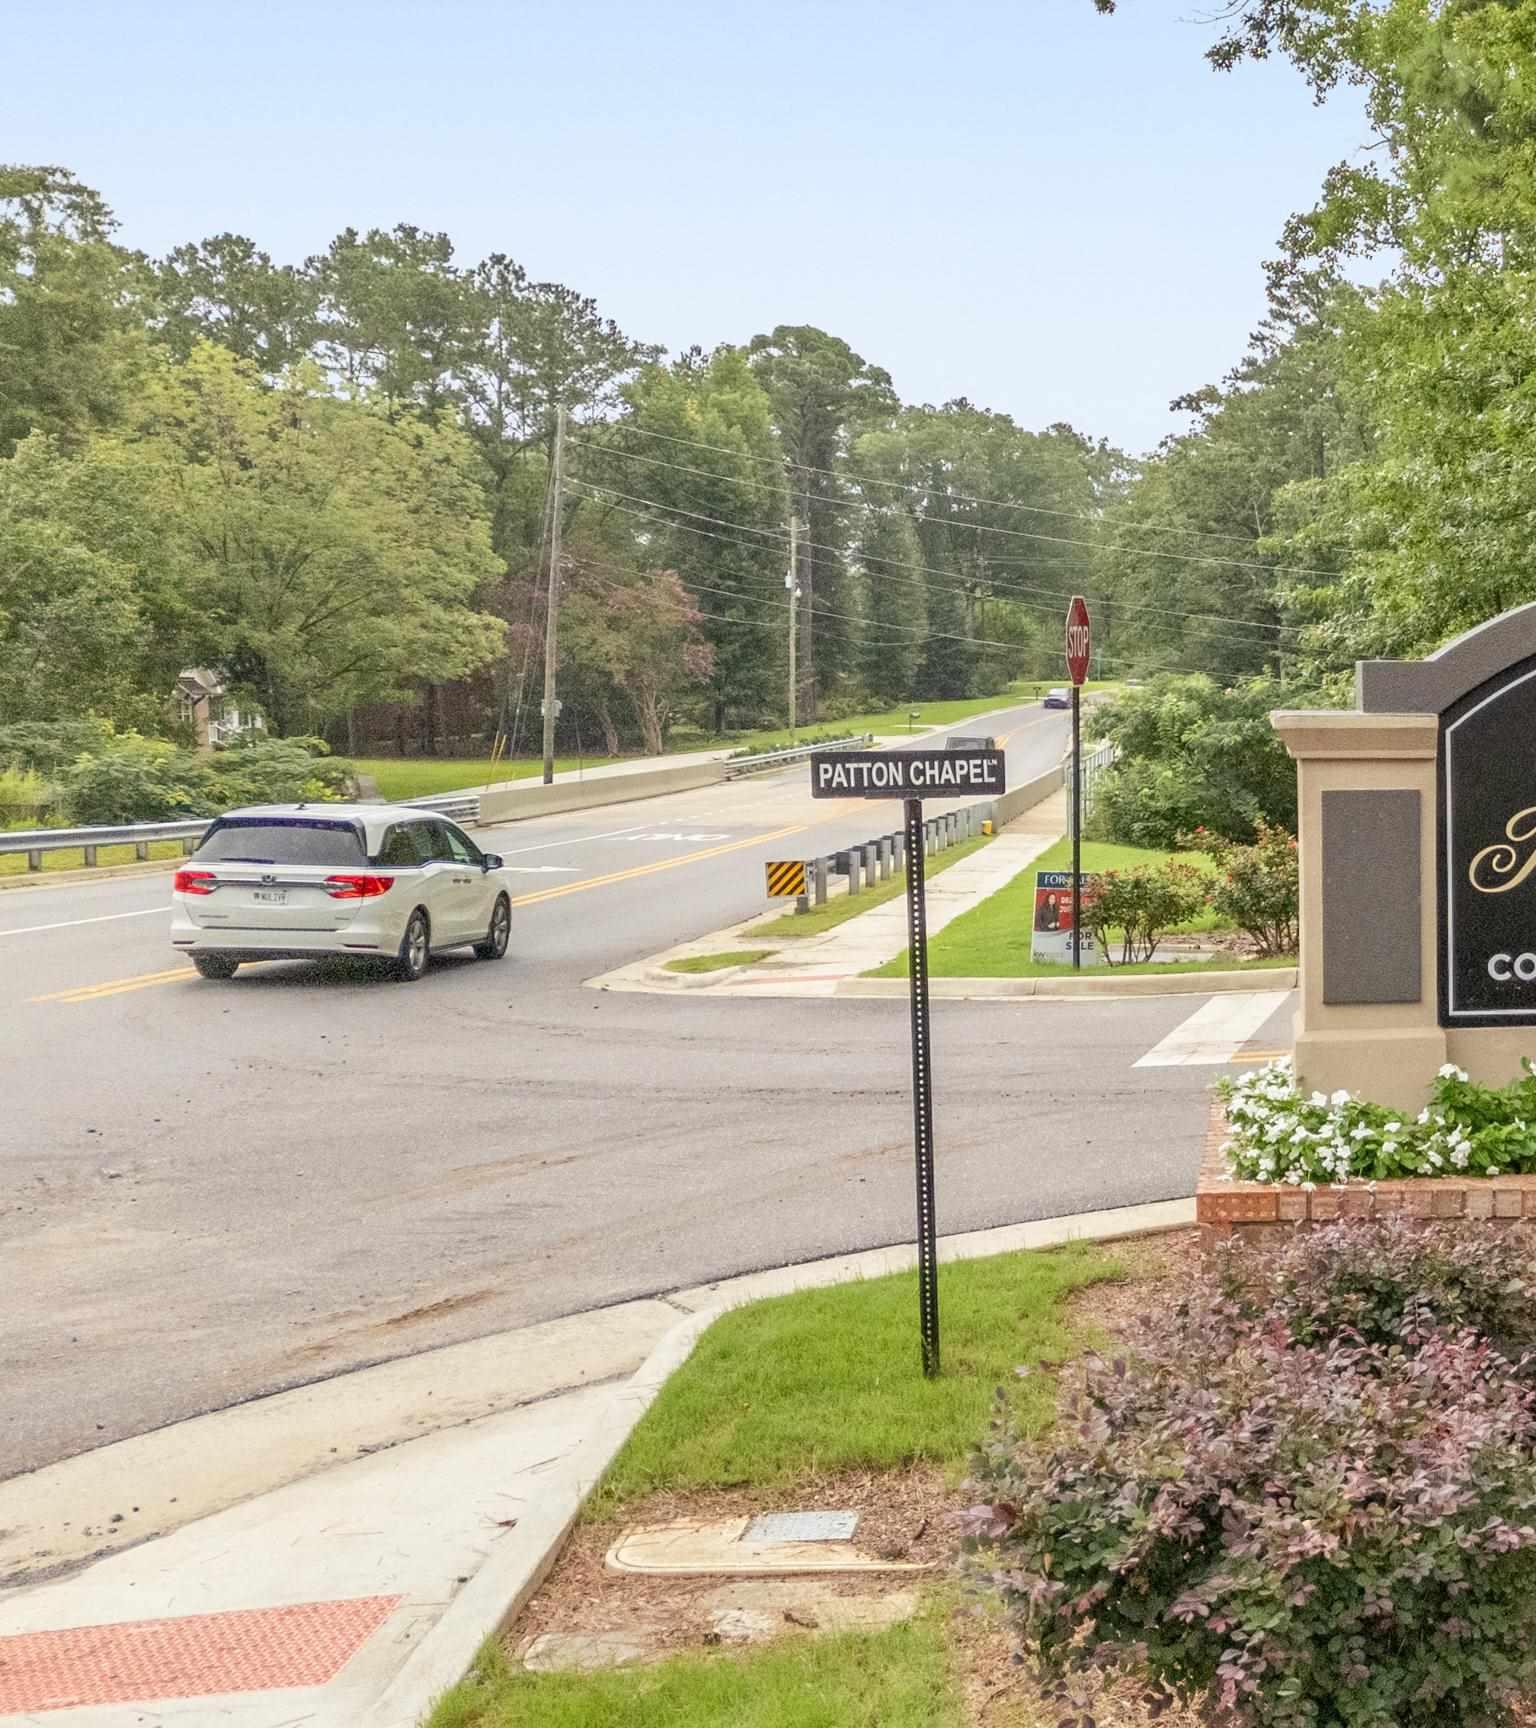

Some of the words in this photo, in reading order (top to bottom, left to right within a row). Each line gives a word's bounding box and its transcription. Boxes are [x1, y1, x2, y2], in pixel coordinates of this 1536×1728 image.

[1068, 625, 1089, 659] STOP
[819, 761, 903, 788] PATTON
[909, 759, 996, 785] CHAPEL
[1044, 874, 1066, 885] FOR
[1065, 941, 1094, 951] SLE
